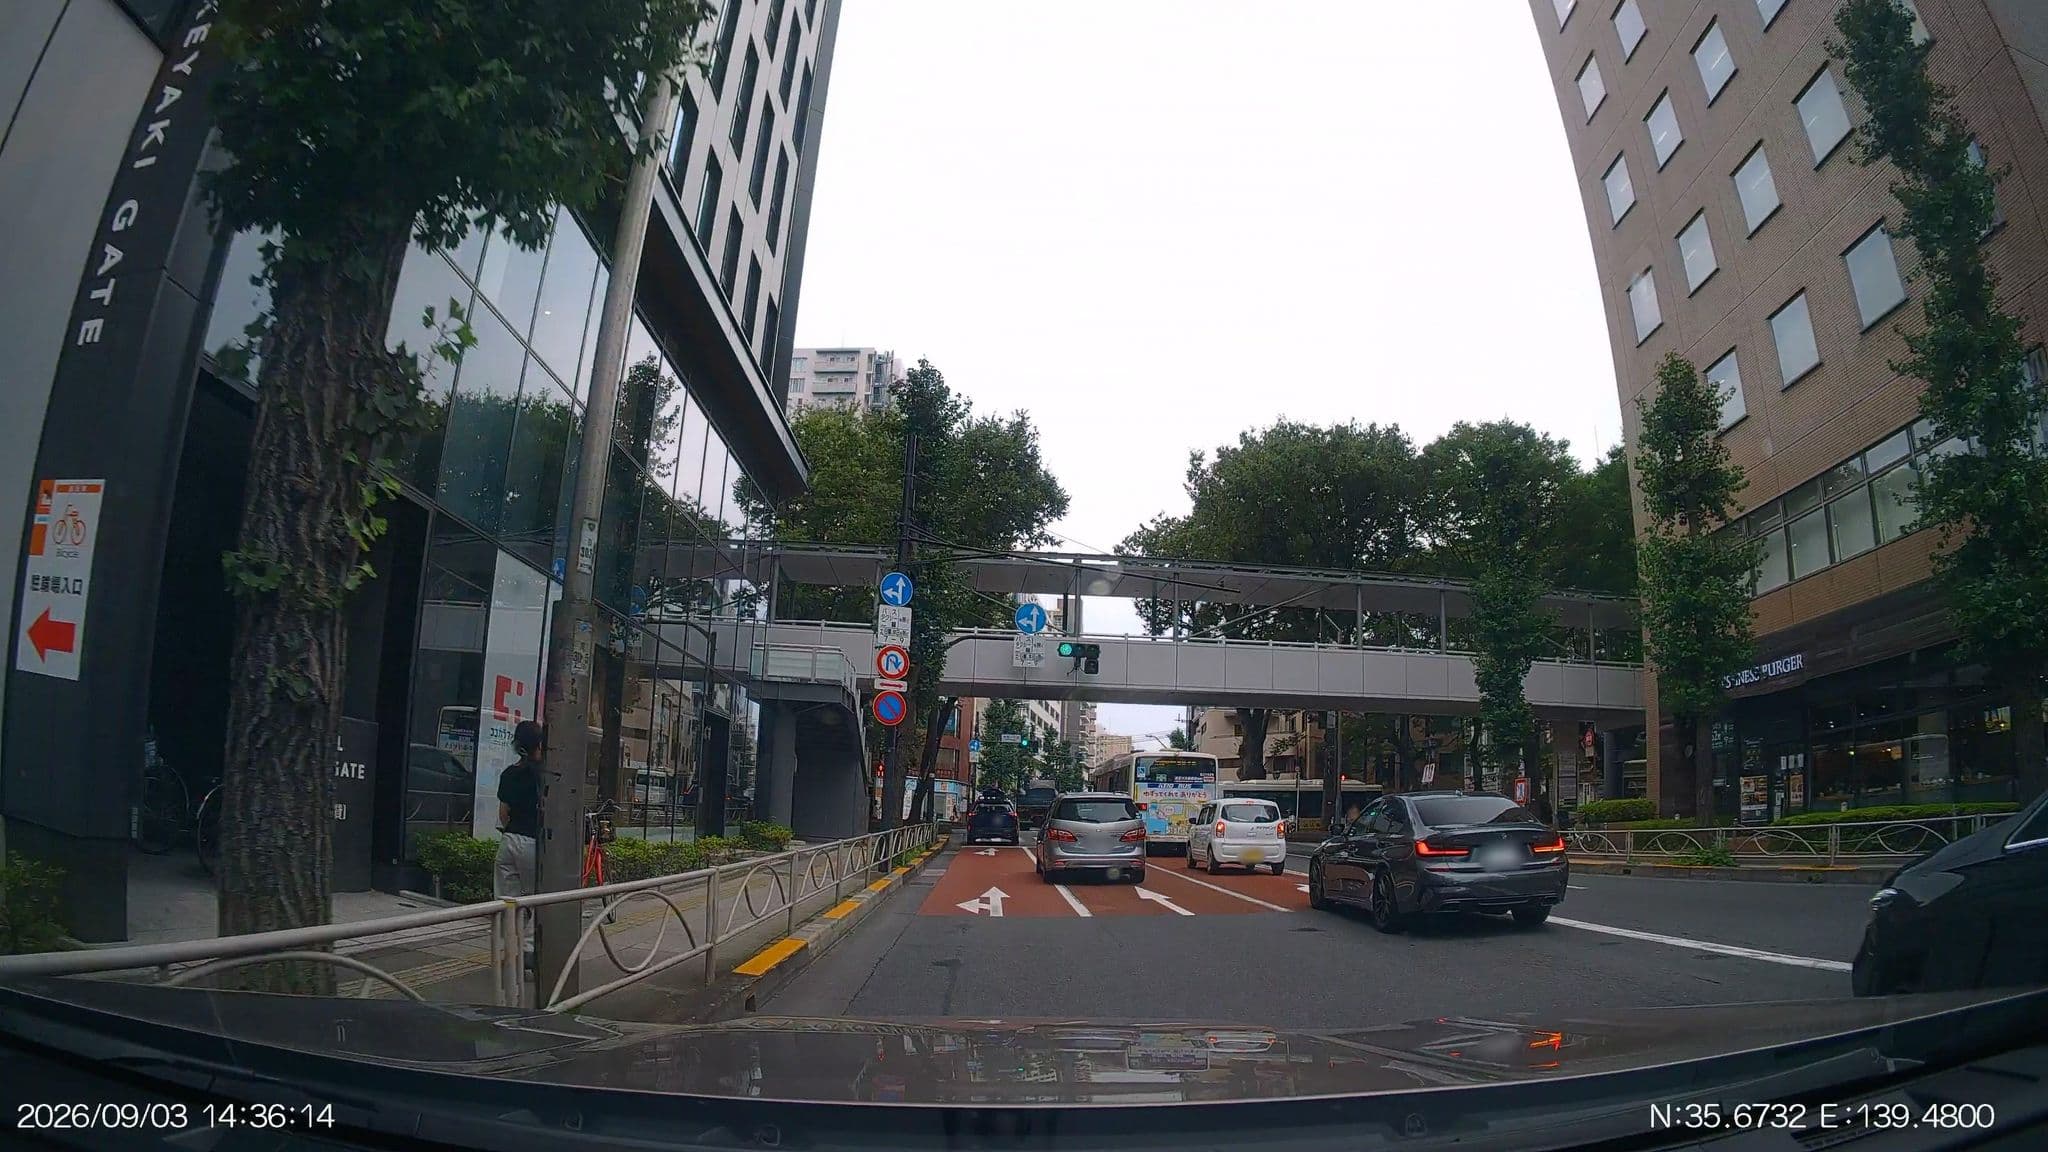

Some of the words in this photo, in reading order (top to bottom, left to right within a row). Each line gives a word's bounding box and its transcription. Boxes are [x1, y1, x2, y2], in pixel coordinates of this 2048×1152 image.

[77, 199, 139, 345] GATE
[30, 575, 83, 595] 駐輪場入口
[1143, 790, 1180, 798] ゆずってくれて
[1180, 790, 1207, 799] ありがとう
